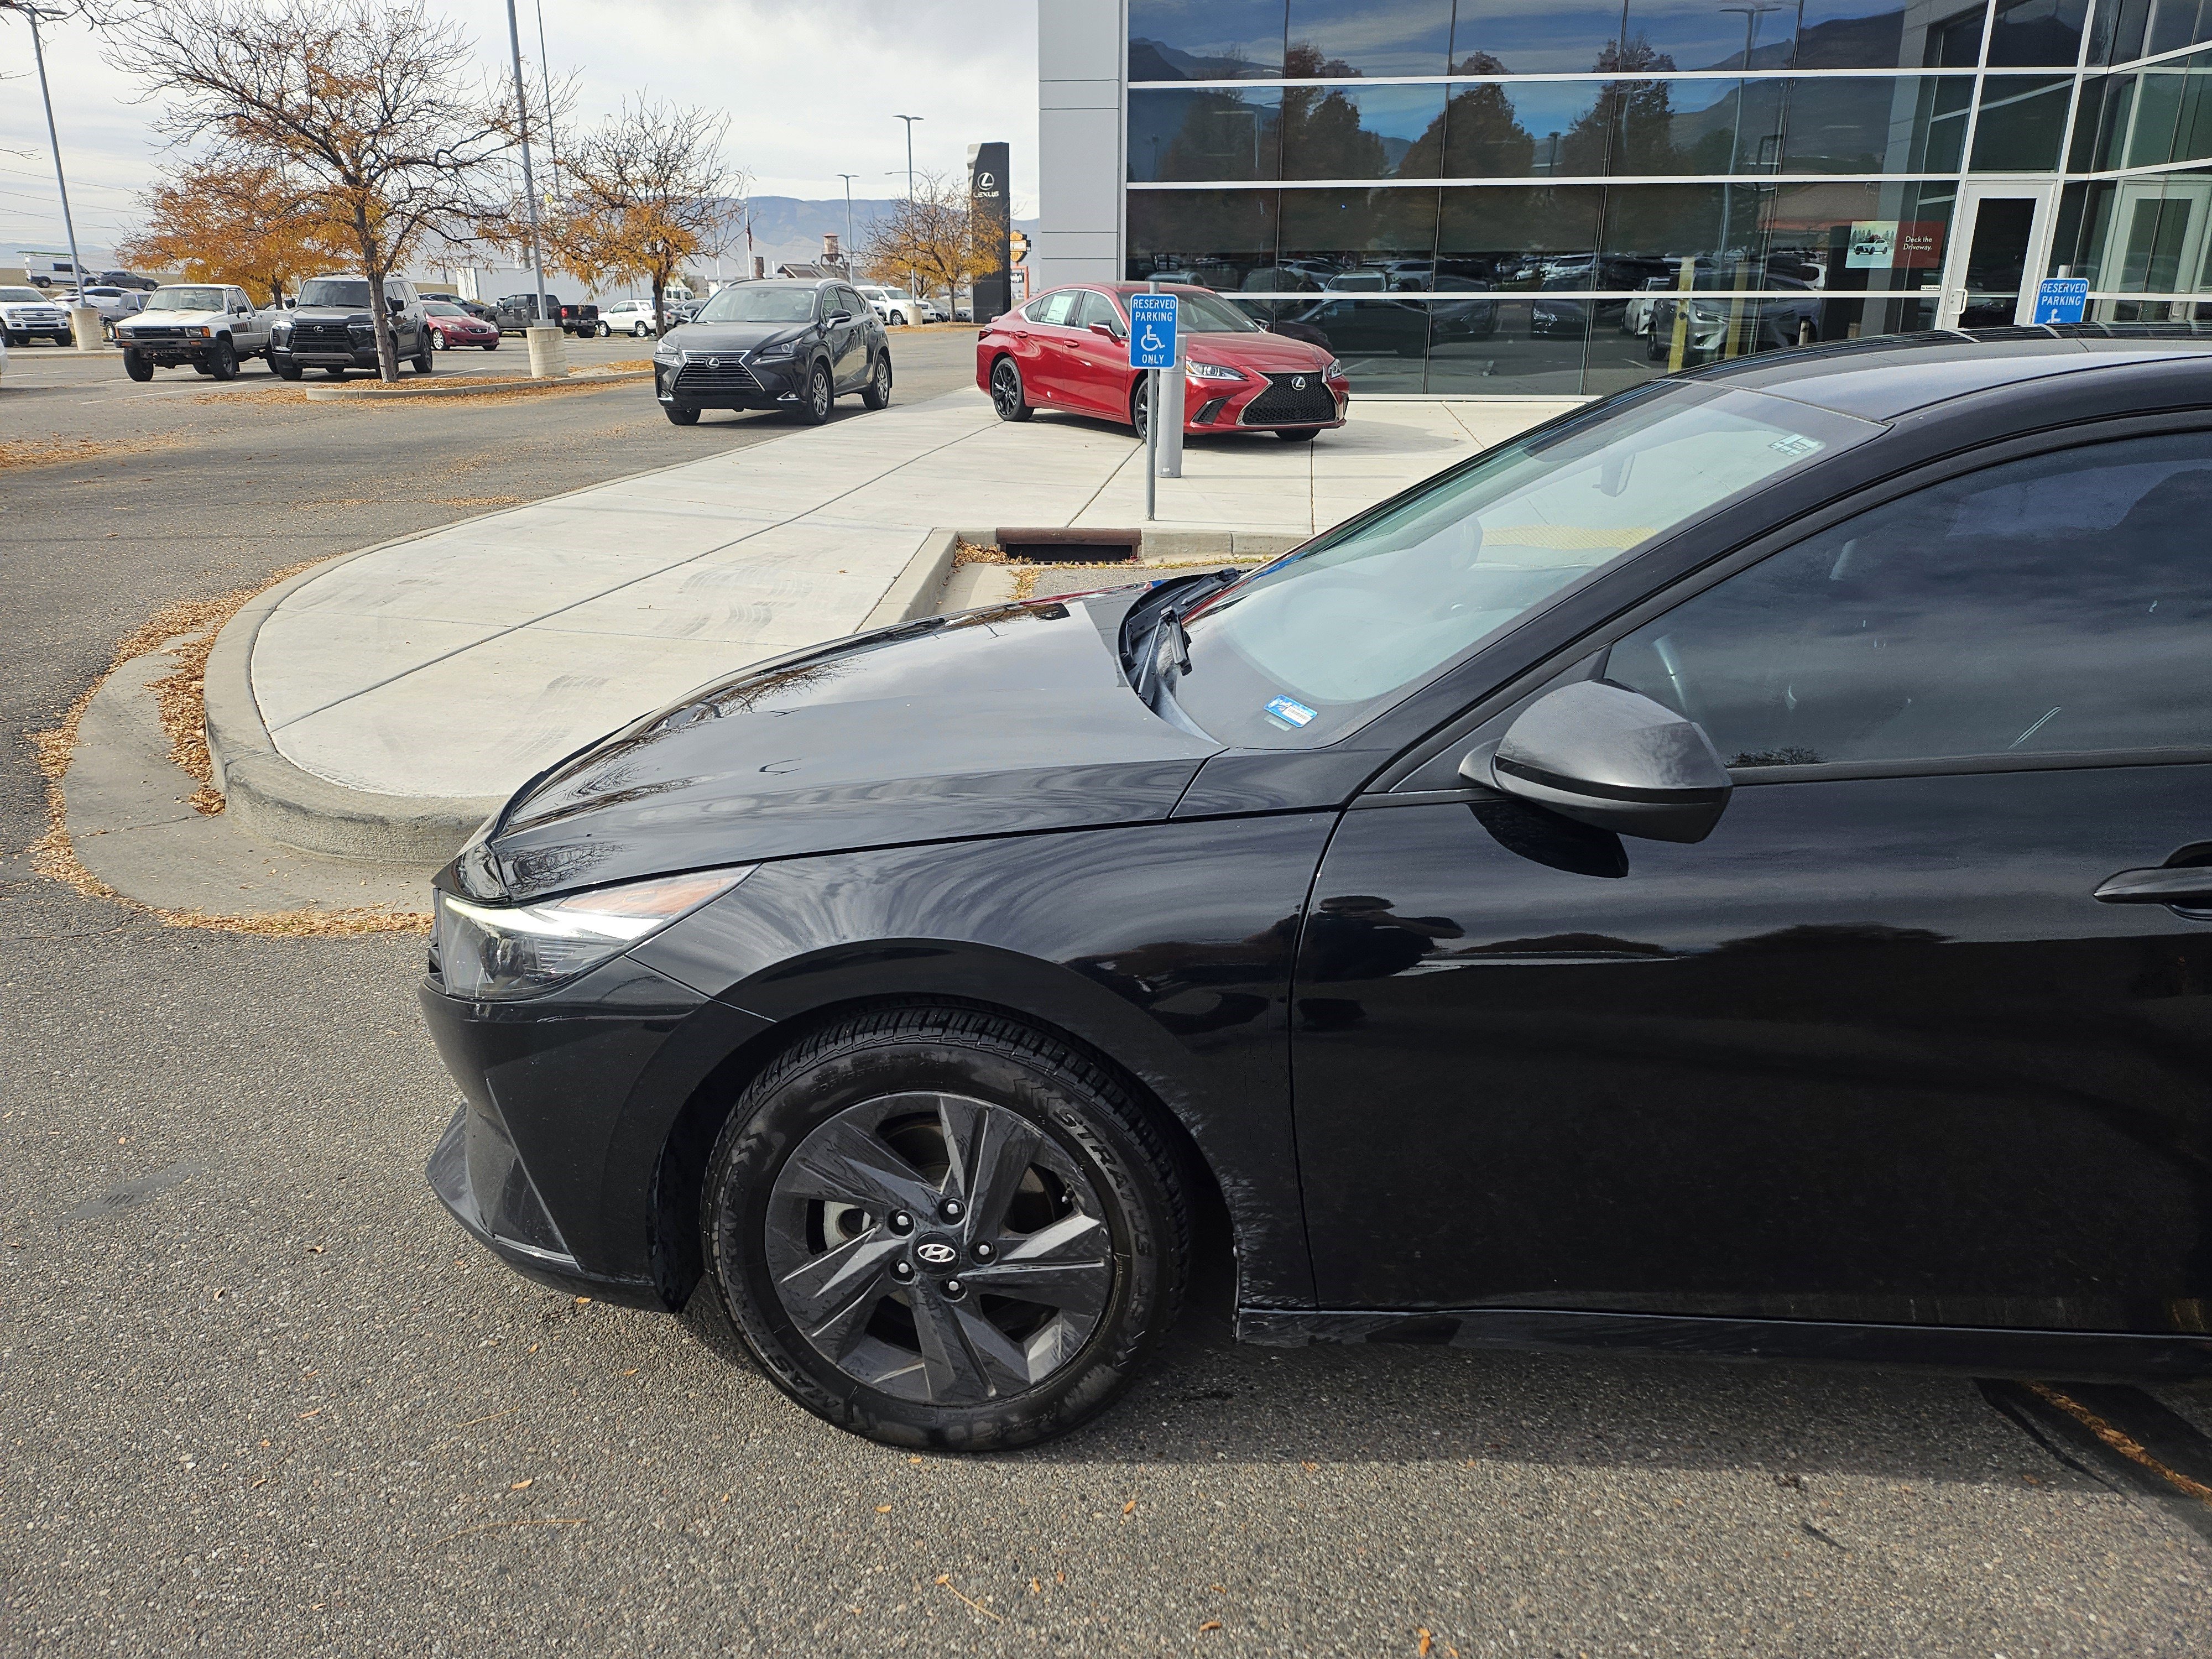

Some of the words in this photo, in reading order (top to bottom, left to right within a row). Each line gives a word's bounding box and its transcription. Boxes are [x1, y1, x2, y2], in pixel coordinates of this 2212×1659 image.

[1903, 243, 1932, 252] Driveway.
[2041, 283, 2086, 293] RESERVED
[1133, 299, 1176, 309] RESERVED
[2041, 295, 2081, 306] PARKING
[1135, 311, 1173, 322] PARKING
[1142, 354, 1165, 365] ONLY
[1052, 1107, 1154, 1257] STRATUS
